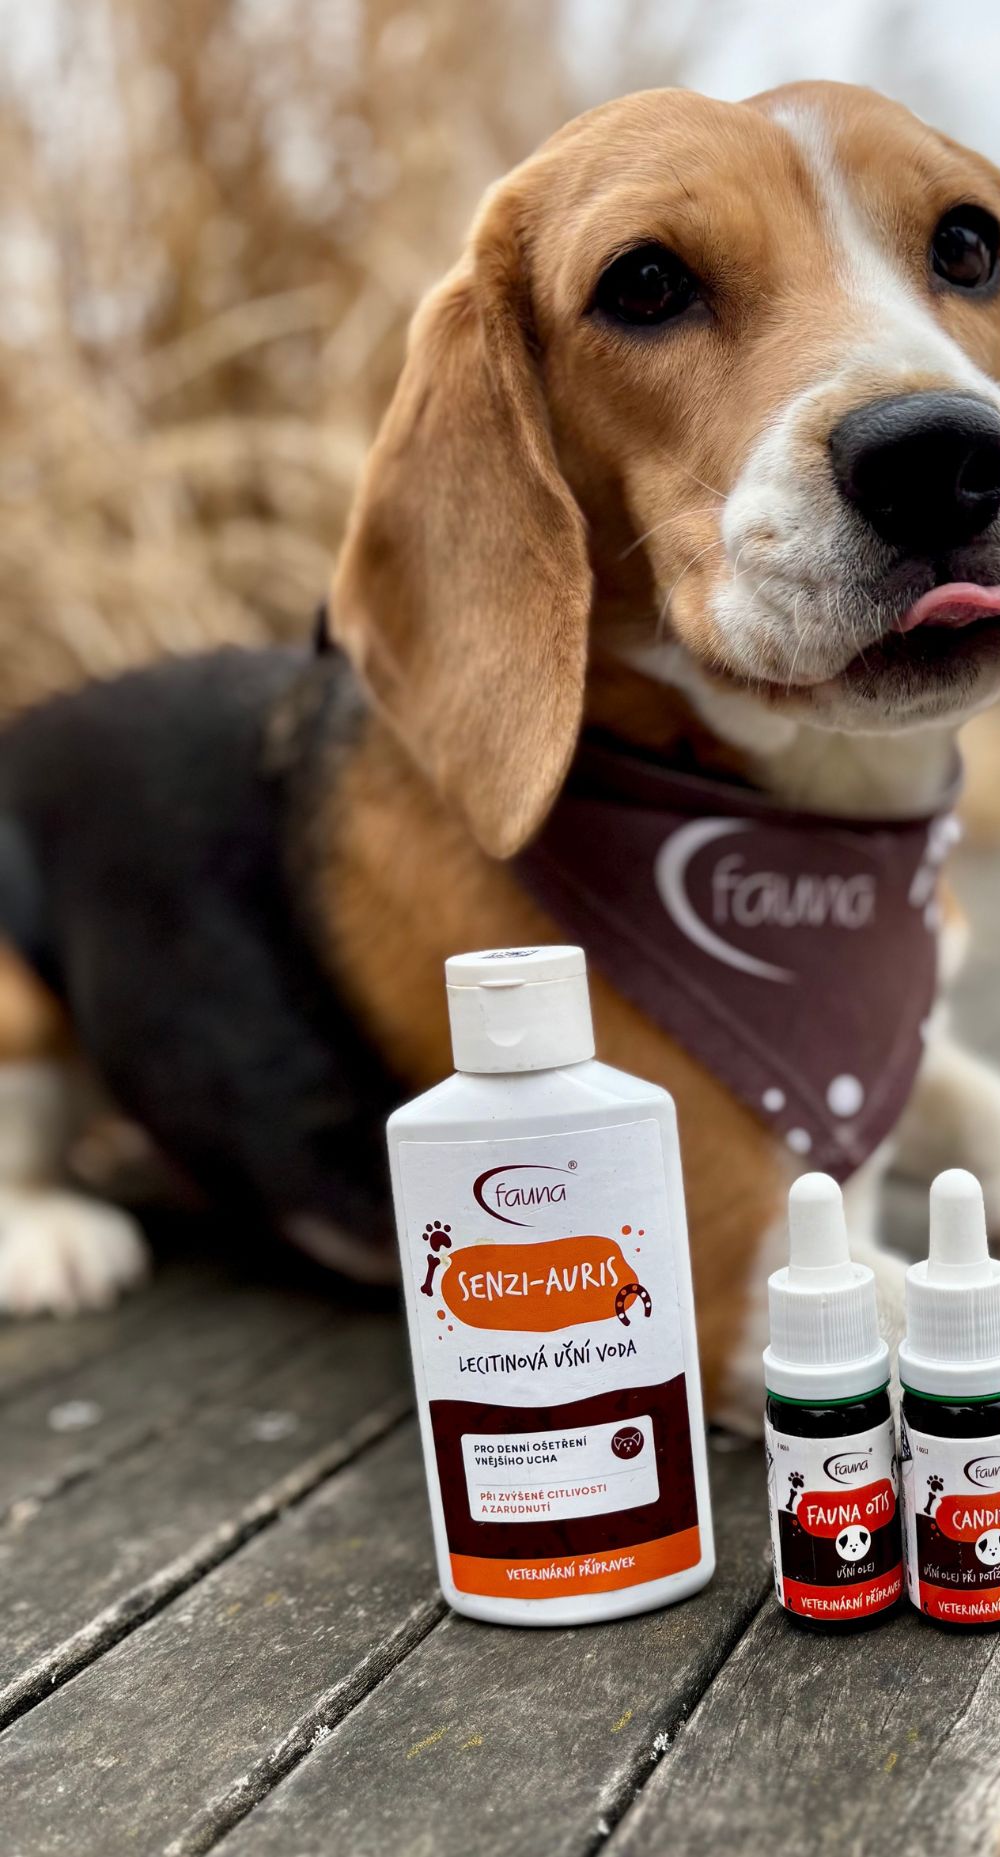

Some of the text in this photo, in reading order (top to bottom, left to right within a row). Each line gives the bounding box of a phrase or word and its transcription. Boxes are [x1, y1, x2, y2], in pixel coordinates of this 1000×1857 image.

[712, 853, 877, 929] fauna
[495, 1182, 567, 1208] fauna
[457, 1256, 619, 1302] SENZI-AURIS
[459, 1339, 637, 1375] LECITINOVÁ UŠNÍ VODA
[474, 1435, 587, 1454] PRO DENNÍ OŠETŘENÍ
[475, 1454, 558, 1468] VNĚJŠÍHO UCHA
[834, 1460, 869, 1476] fauna
[480, 1483, 607, 1502] PŘI ZVÝŠENÉ CITLIVOSTI
[481, 1501, 551, 1514] A ZARUDNUTÍ
[806, 1489, 890, 1527] FAUNA OTIS
[506, 1556, 636, 1581] VETERINÁRNÍ PŘÍPRAVEK
[836, 1561, 875, 1579] UŠNÍ OLEJ
[923, 1563, 940, 1579] UŠNÍ
[941, 1571, 960, 1583] OLEJ
[962, 1568, 976, 1584] PŘI
[800, 1592, 863, 1611] VETERINÁRNÍ
